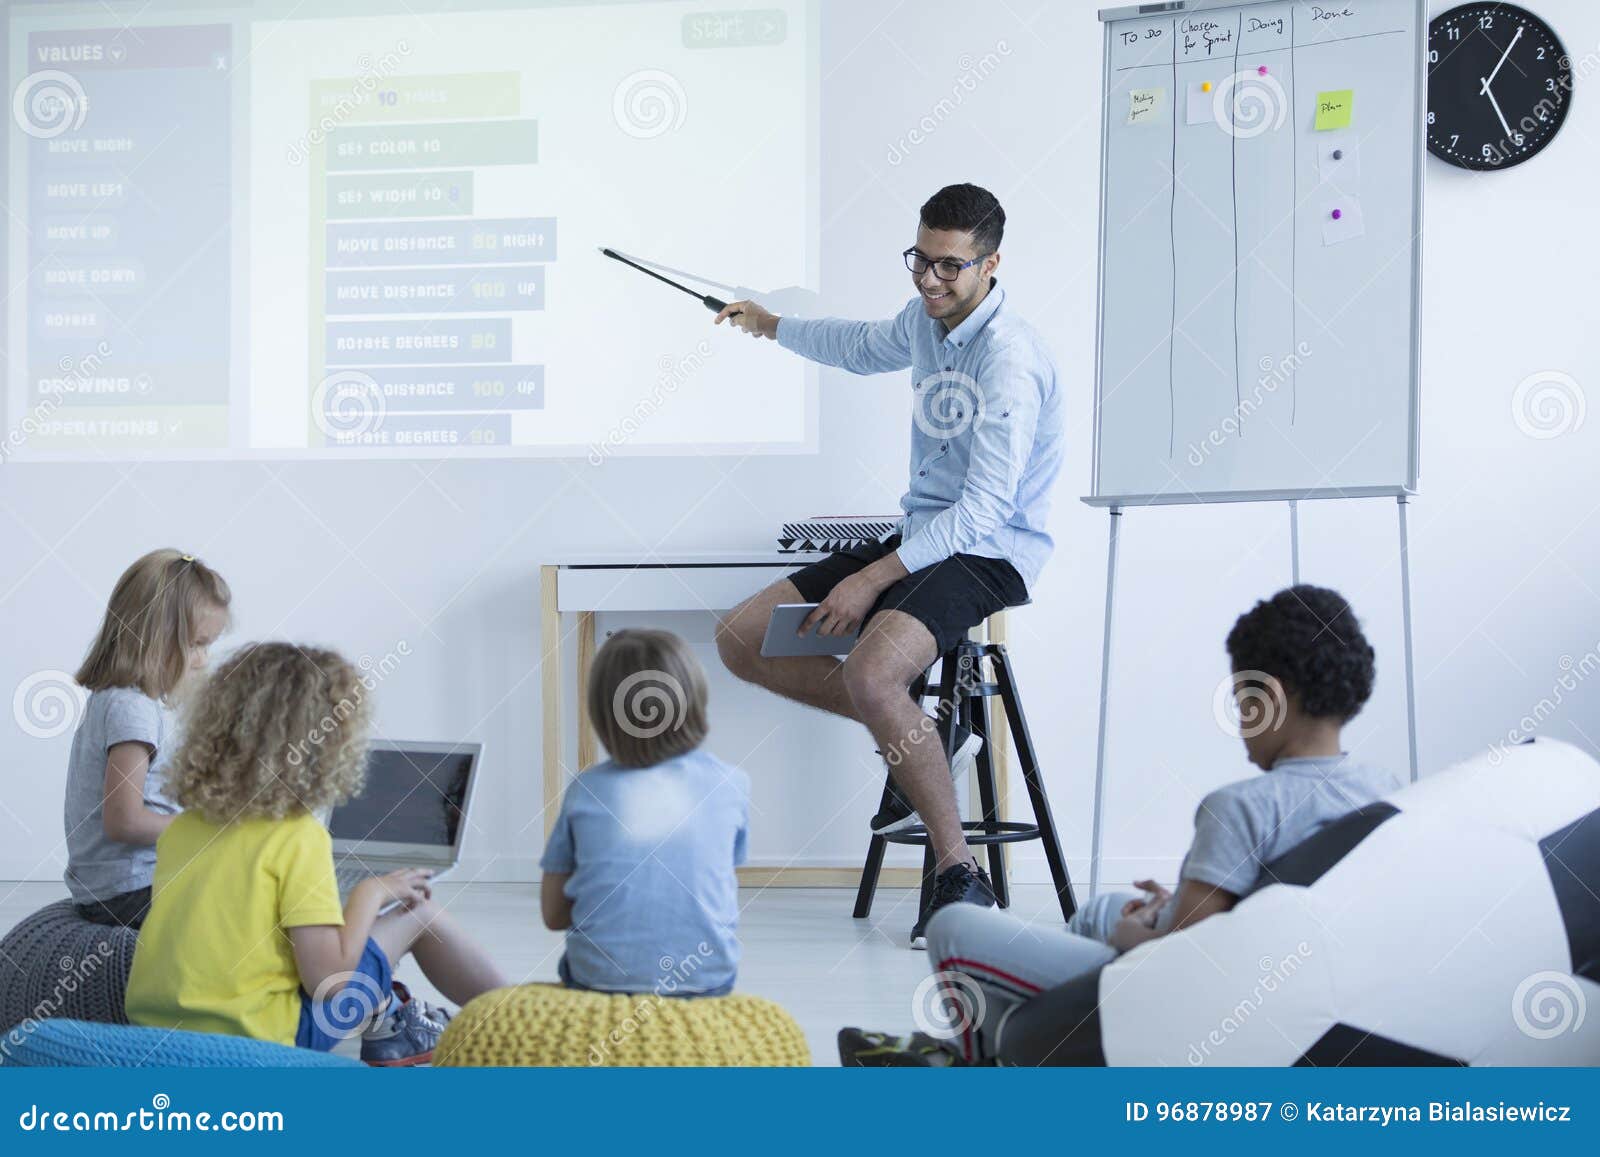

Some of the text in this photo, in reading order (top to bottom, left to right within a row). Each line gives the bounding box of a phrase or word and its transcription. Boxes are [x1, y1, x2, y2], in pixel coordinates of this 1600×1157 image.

[1311, 7, 1354, 20] Done
[1180, 19, 1219, 33] Chosen
[1247, 18, 1283, 34] Doing
[1479, 17, 1493, 29] 12
[1447, 28, 1459, 40] 11
[1184, 29, 1232, 55] for Sprint
[1536, 47, 1545, 60] 2
[1546, 79, 1554, 91] 3
[378, 91, 397, 106] 10
[1427, 112, 1435, 124] 8
[1539, 110, 1547, 122] 4
[1450, 135, 1459, 147] 7
[1515, 134, 1524, 146] 5
[369, 139, 416, 155] COLOR
[1482, 144, 1491, 156] 6
[337, 238, 379, 254] MOVE
[503, 232, 545, 248] RIGHT
[337, 285, 379, 300] MOVE
[517, 282, 536, 297] UP
[395, 335, 458, 349] DEGREES
[517, 381, 536, 395] UP
[395, 430, 458, 444] DEGREES
